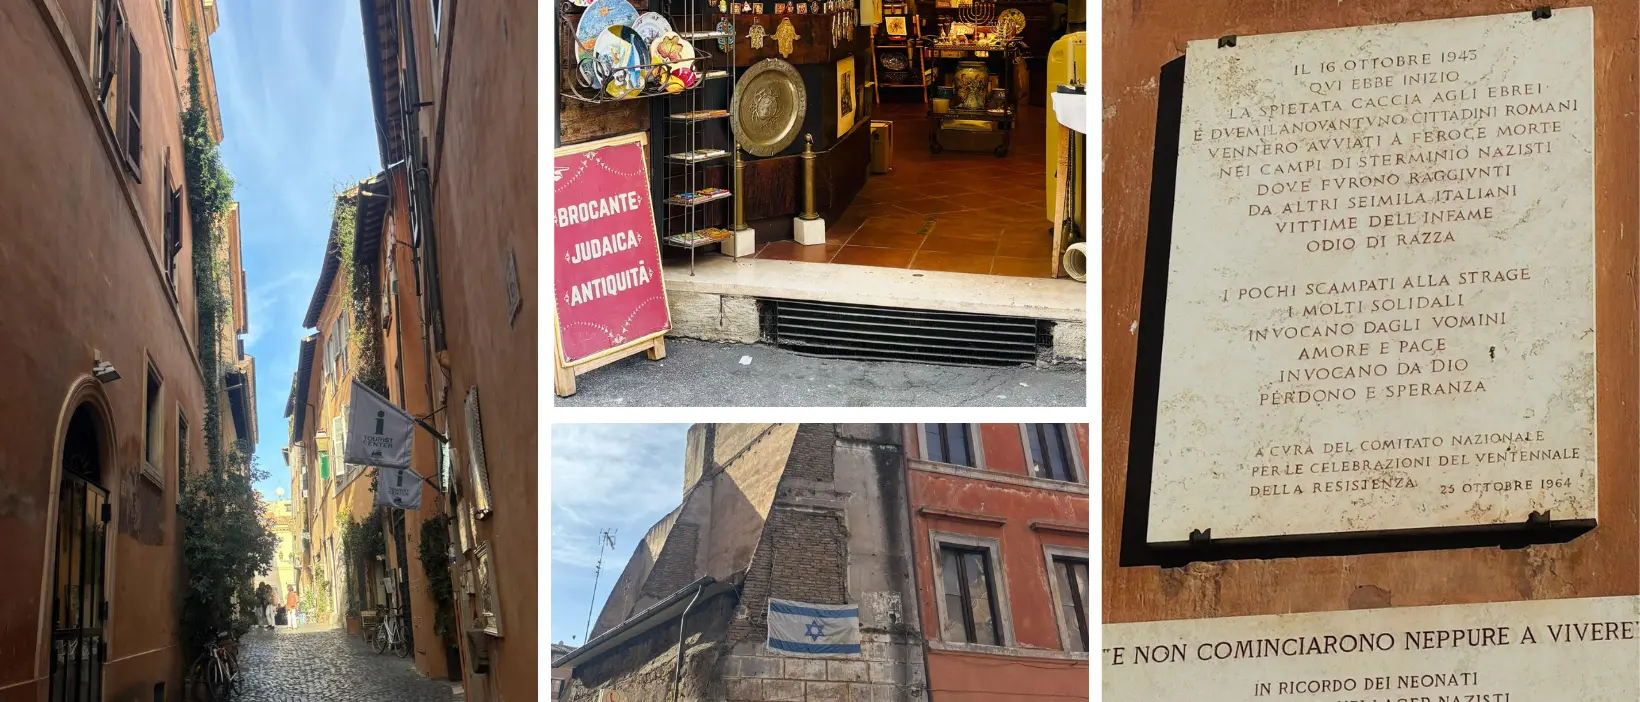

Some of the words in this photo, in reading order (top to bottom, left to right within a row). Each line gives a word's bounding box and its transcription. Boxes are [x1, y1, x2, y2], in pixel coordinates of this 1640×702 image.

[1294, 64, 1310, 76] IL
[1321, 62, 1336, 73] 16
[1344, 54, 1431, 71] OTTOBRE
[1441, 50, 1477, 63] 1943
[1310, 80, 1341, 95] QVI
[1352, 76, 1393, 90] EBBE
[1403, 71, 1459, 86] INIZIO
[1229, 108, 1251, 119] LA
[1259, 100, 1342, 117] SPIETATA
[1352, 94, 1422, 109] CACCIA
[1432, 88, 1477, 103] AGLI
[1488, 83, 1542, 98] EBREI
[1412, 106, 1497, 123] CITTADINI
[1505, 99, 1578, 116] ROMANI
[1208, 142, 1298, 159] VENNERO
[1307, 136, 1381, 152] AVVIATI
[1412, 127, 1487, 143] FEROCE
[1497, 121, 1562, 137] MORTE
[1219, 166, 1251, 178] NEI
[1260, 160, 1321, 175] CAMPI
[1332, 157, 1351, 169] DI
[1358, 148, 1469, 168] STERMINIO
[1478, 141, 1551, 158] NAZISTI
[1257, 181, 1310, 196] DOVE
[1321, 173, 1400, 191] FVRONO
[1409, 164, 1511, 185] RAGGIVNTI
[557, 190, 639, 228] BROCANTE
[1248, 204, 1272, 216] DA
[1282, 198, 1338, 213] ALTRI
[1347, 192, 1426, 209] SEIMILA
[1436, 184, 1517, 202] ITALIANI
[1275, 217, 1358, 233] VITTIME
[571, 229, 639, 264] JUDAICA
[1306, 237, 1356, 252] ODIO
[1366, 235, 1386, 249] DI
[1397, 231, 1455, 246] RAZZA
[1222, 289, 1229, 302] I
[1238, 285, 1296, 300] POCHI
[1305, 277, 1395, 296] SCAMPATI
[1402, 274, 1451, 289] ALLA
[1458, 268, 1531, 285] STRAGE
[1287, 305, 1293, 318] I
[1302, 301, 1363, 317] MOLTI
[1371, 294, 1464, 312] SOLIDALI
[1249, 322, 1354, 341] INVOCANO
[1363, 318, 1420, 334] DAGLI
[1432, 312, 1506, 328] VOMINI
[1298, 343, 1370, 360] AMORE
[1380, 342, 1389, 354] E
[1399, 338, 1446, 353] PACE
[1280, 363, 1388, 383] INVOCANO
[1397, 362, 1421, 375] DA
[1431, 358, 1468, 373] DIO
[1259, 387, 1356, 406] PERDONO
[1366, 386, 1376, 399] E
[1386, 380, 1487, 398] SPERANZA
[362, 440, 393, 448] CENTER
[363, 435, 393, 444] TOURIST
[1255, 446, 1264, 457] A
[1270, 444, 1314, 457] CVRA
[1323, 442, 1354, 454] DEL
[1360, 436, 1443, 451] COMITATO
[1451, 430, 1545, 446] NAZIONALE
[1252, 465, 1281, 477] PER
[1285, 464, 1304, 475] LE
[1310, 456, 1431, 474] CELEBRAZIONI
[1438, 454, 1470, 467] DEL
[1475, 448, 1580, 464] VENTENNALE
[1250, 484, 1303, 497] DELLA
[1312, 477, 1416, 493] RESISTENZA
[1440, 484, 1455, 495] 25
[1462, 480, 1533, 493] OTTOBRE
[1541, 478, 1571, 489] 1964
[1133, 643, 1187, 665] NON
[1197, 632, 1395, 662] COMINCIARONO
[1404, 626, 1510, 650] NEPPURE
[1520, 626, 1537, 644] A
[1254, 682, 1272, 697] IN
[1279, 677, 1357, 695] RICORDO
[1364, 676, 1391, 691] DEI
[1397, 672, 1478, 689] NEONATI
